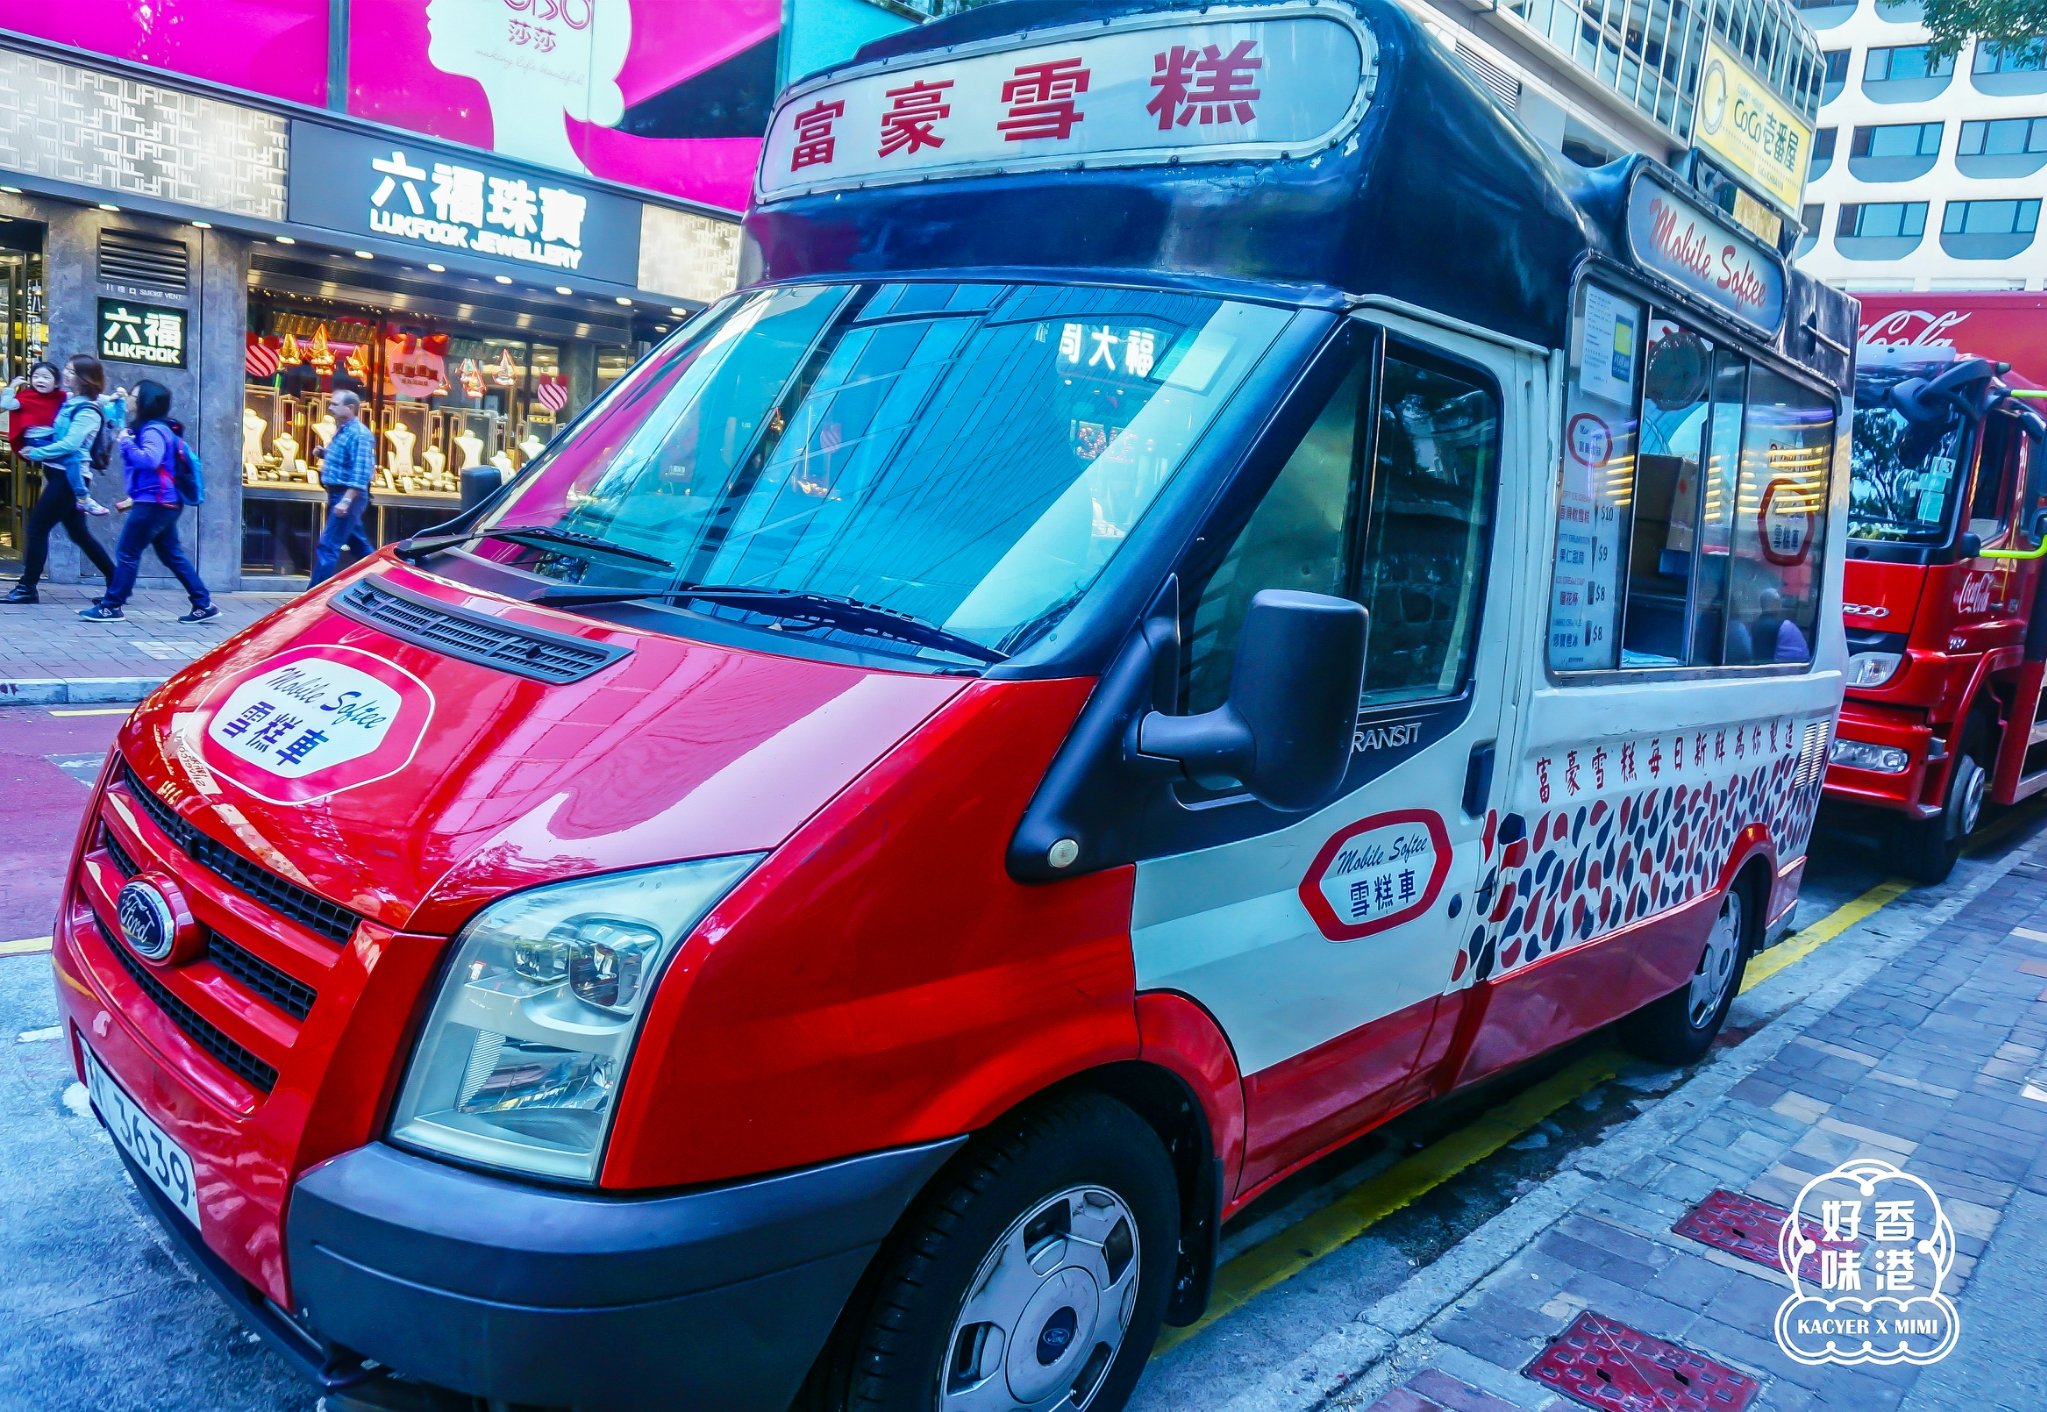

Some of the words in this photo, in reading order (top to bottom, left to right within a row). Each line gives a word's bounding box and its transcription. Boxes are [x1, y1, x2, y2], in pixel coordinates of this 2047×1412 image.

[508, 19, 557, 53] 莎莎
[790, 39, 1264, 173] 富豪雪糕
[370, 151, 587, 248] 六福珠寶
[369, 208, 469, 249] LUKFOOK
[470, 229, 583, 270] JEWELLERY
[1649, 197, 1711, 281] Mobile
[1717, 245, 1766, 311] Softee
[104, 307, 181, 349] 六福
[103, 341, 181, 364] LUKFOOK
[1601, 506, 1614, 521] $10
[1598, 546, 1608, 562] $9
[1595, 585, 1606, 601] $8
[1593, 626, 1603, 641] $8
[265, 667, 329, 704] Mobile
[320, 691, 387, 730] Softee
[222, 701, 330, 767] 雪糕車
[1351, 722, 1422, 753] RANSIT
[1337, 844, 1383, 876] Mobile
[1388, 833, 1428, 864] Softee
[1350, 868, 1416, 918] 雪糕車
[121, 894, 155, 943] Ford
